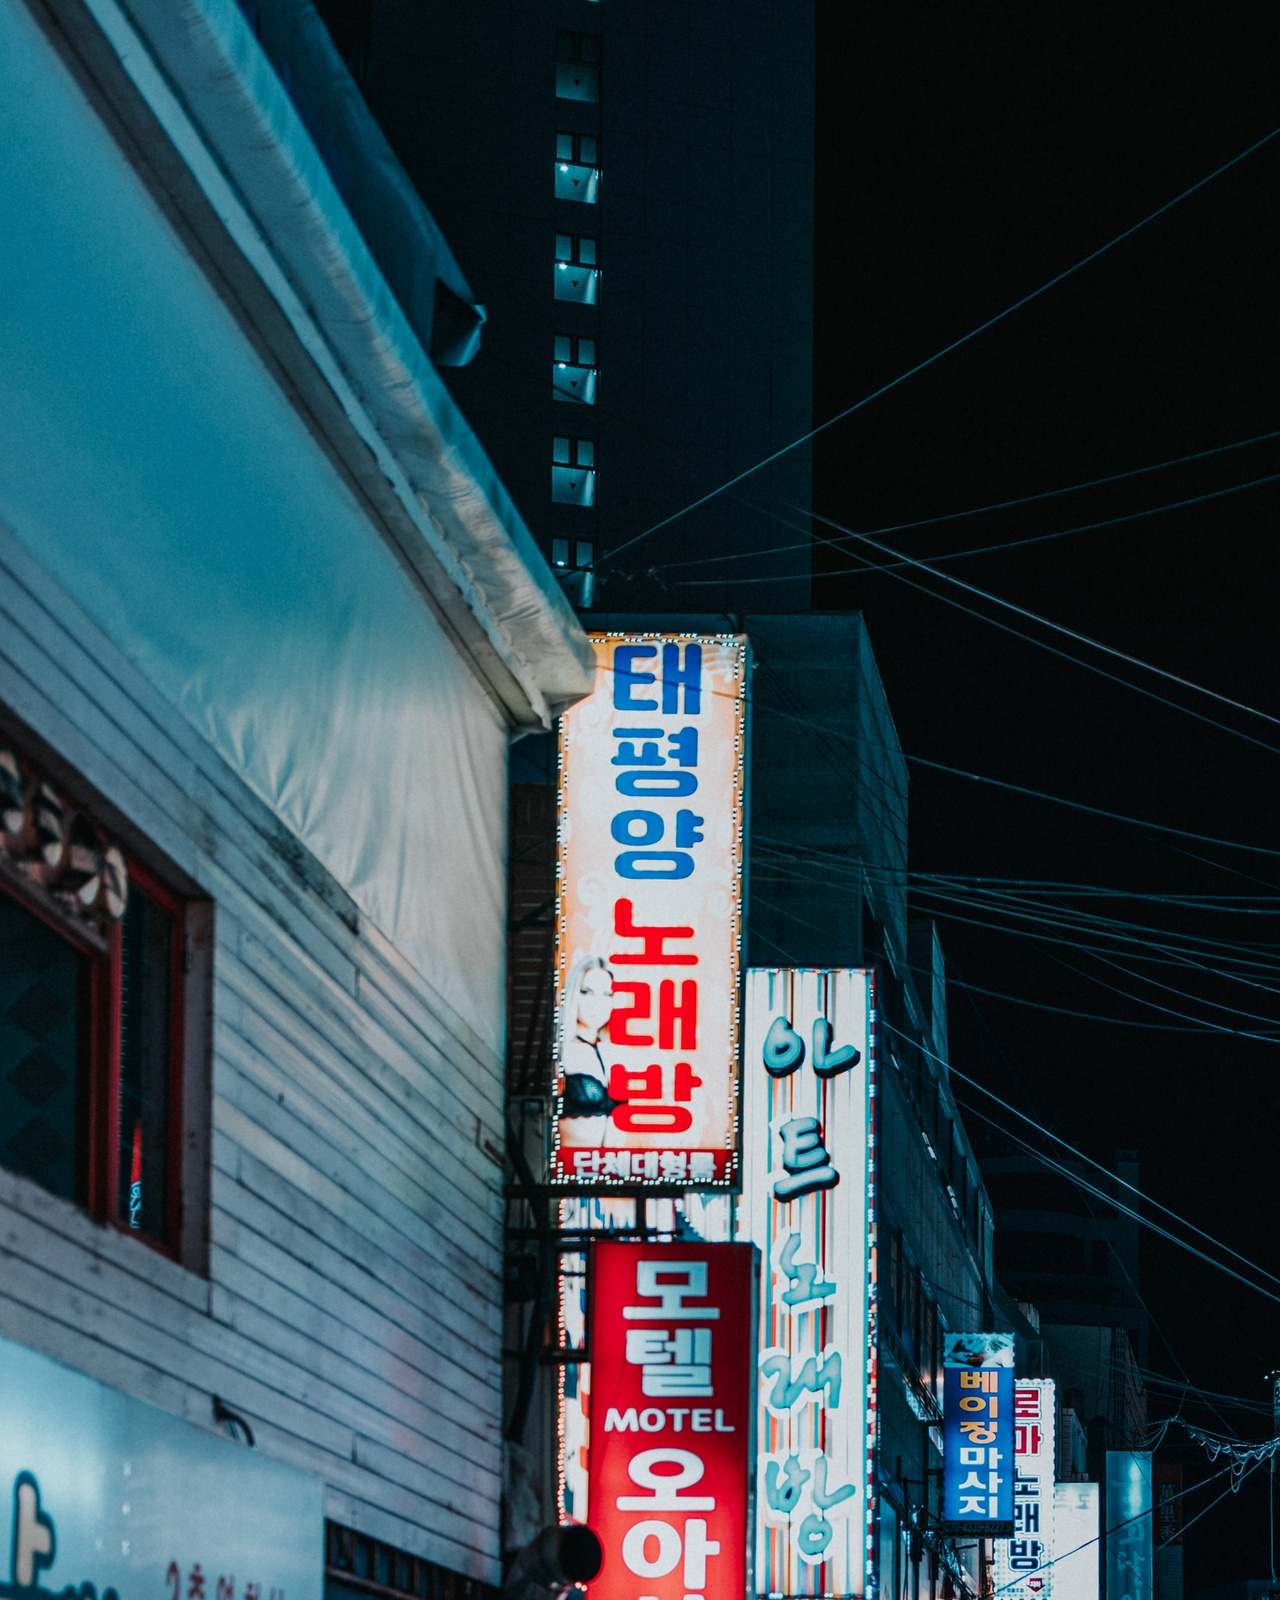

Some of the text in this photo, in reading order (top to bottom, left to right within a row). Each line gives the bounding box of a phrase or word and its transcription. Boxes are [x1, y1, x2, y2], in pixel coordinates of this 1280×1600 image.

[610, 642, 705, 880] 태평양
[608, 896, 703, 1134] 노래방
[572, 1150, 718, 1180] 단체대형룸
[622, 1260, 721, 1398] 모텔
[759, 1232, 858, 1557] 노래방
[603, 1407, 736, 1434] MOTEL
[1009, 1466, 1042, 1571] 노래방
